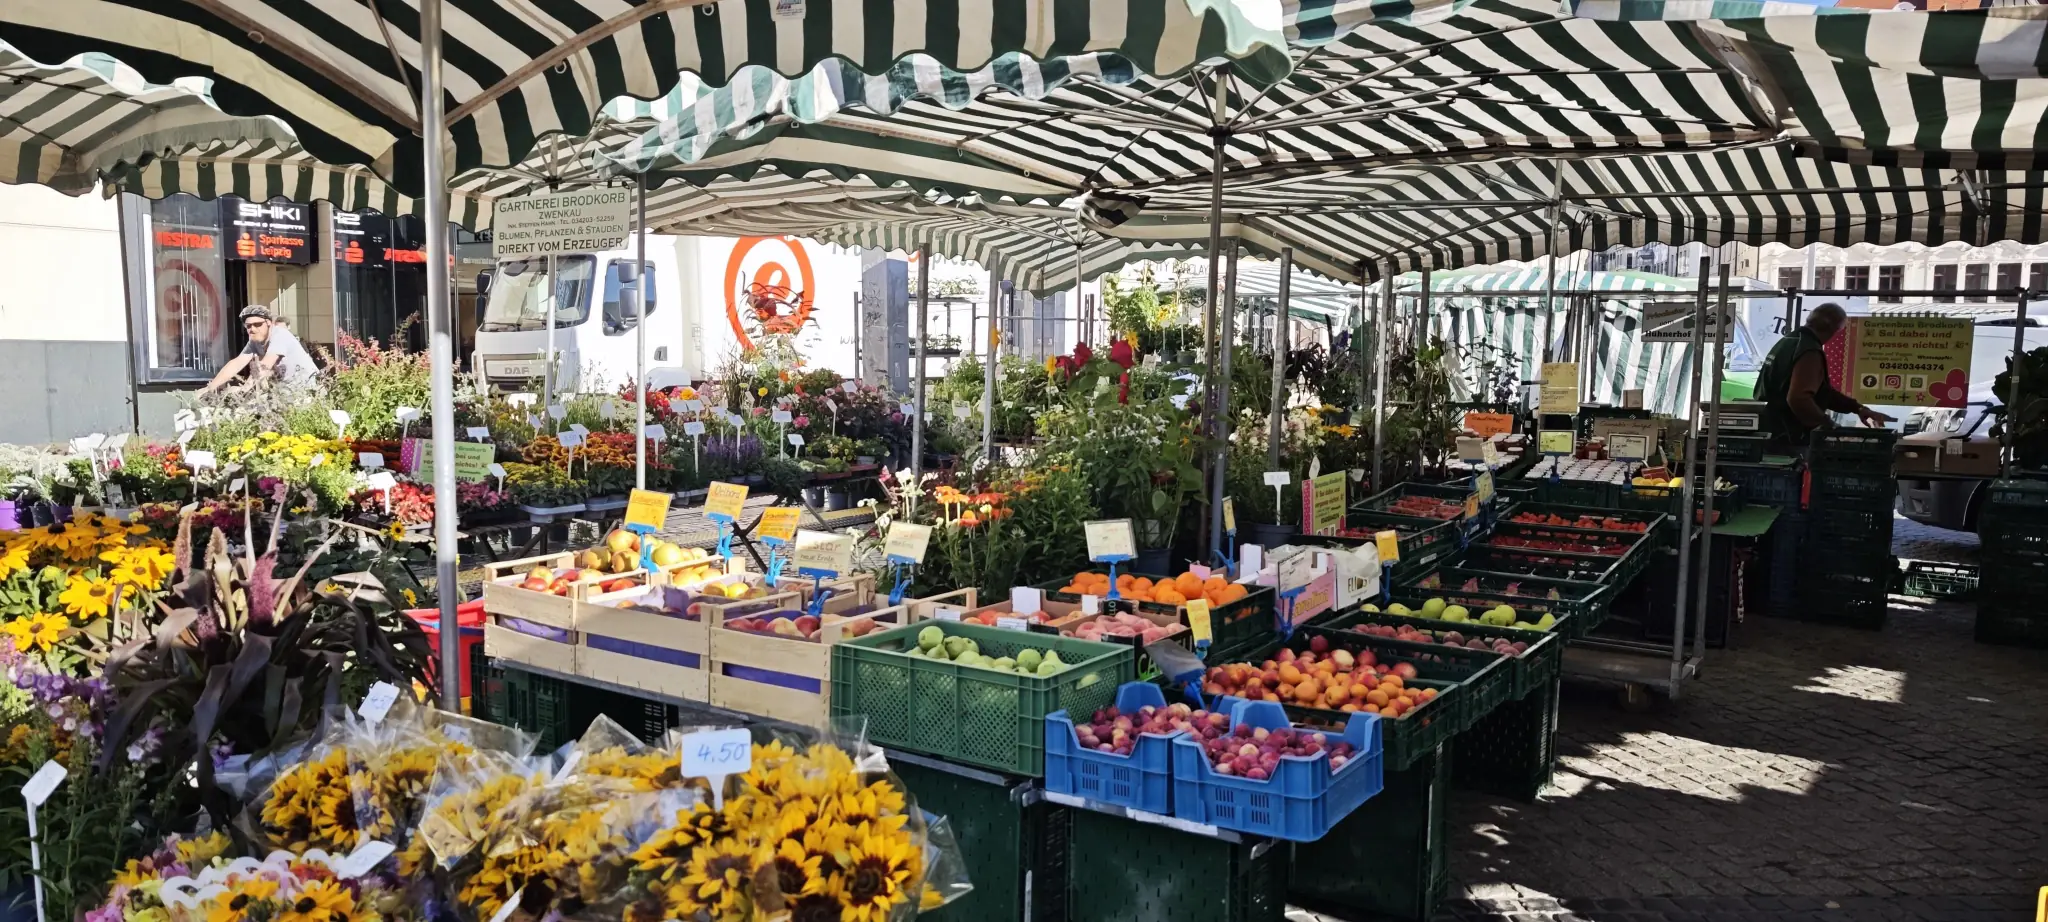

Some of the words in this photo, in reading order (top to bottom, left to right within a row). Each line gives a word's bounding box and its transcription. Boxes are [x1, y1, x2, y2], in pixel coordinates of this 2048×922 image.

[562, 192, 626, 208] BRODKORB
[239, 203, 301, 221] SHIKI
[538, 208, 581, 220] ZWENKAU
[577, 227, 584, 235] &
[259, 234, 304, 247] Sparkasse
[498, 243, 536, 254] DIREKT
[538, 241, 560, 252] VOM
[563, 237, 623, 251] ERZEUGER
[260, 246, 292, 259] Leipzig
[1863, 320, 1915, 329] Gartenbau
[1917, 321, 1964, 329] Brodkorb
[1879, 329, 1896, 338] Sei
[1899, 329, 1929, 338] dabei
[1862, 342, 1909, 350] verpasse
[1912, 341, 1949, 349] nichts!
[504, 366, 530, 375] DAF
[1879, 362, 1944, 371] 03420344374
[1875, 392, 1895, 401] und
[697, 742, 749, 764] 4.50
